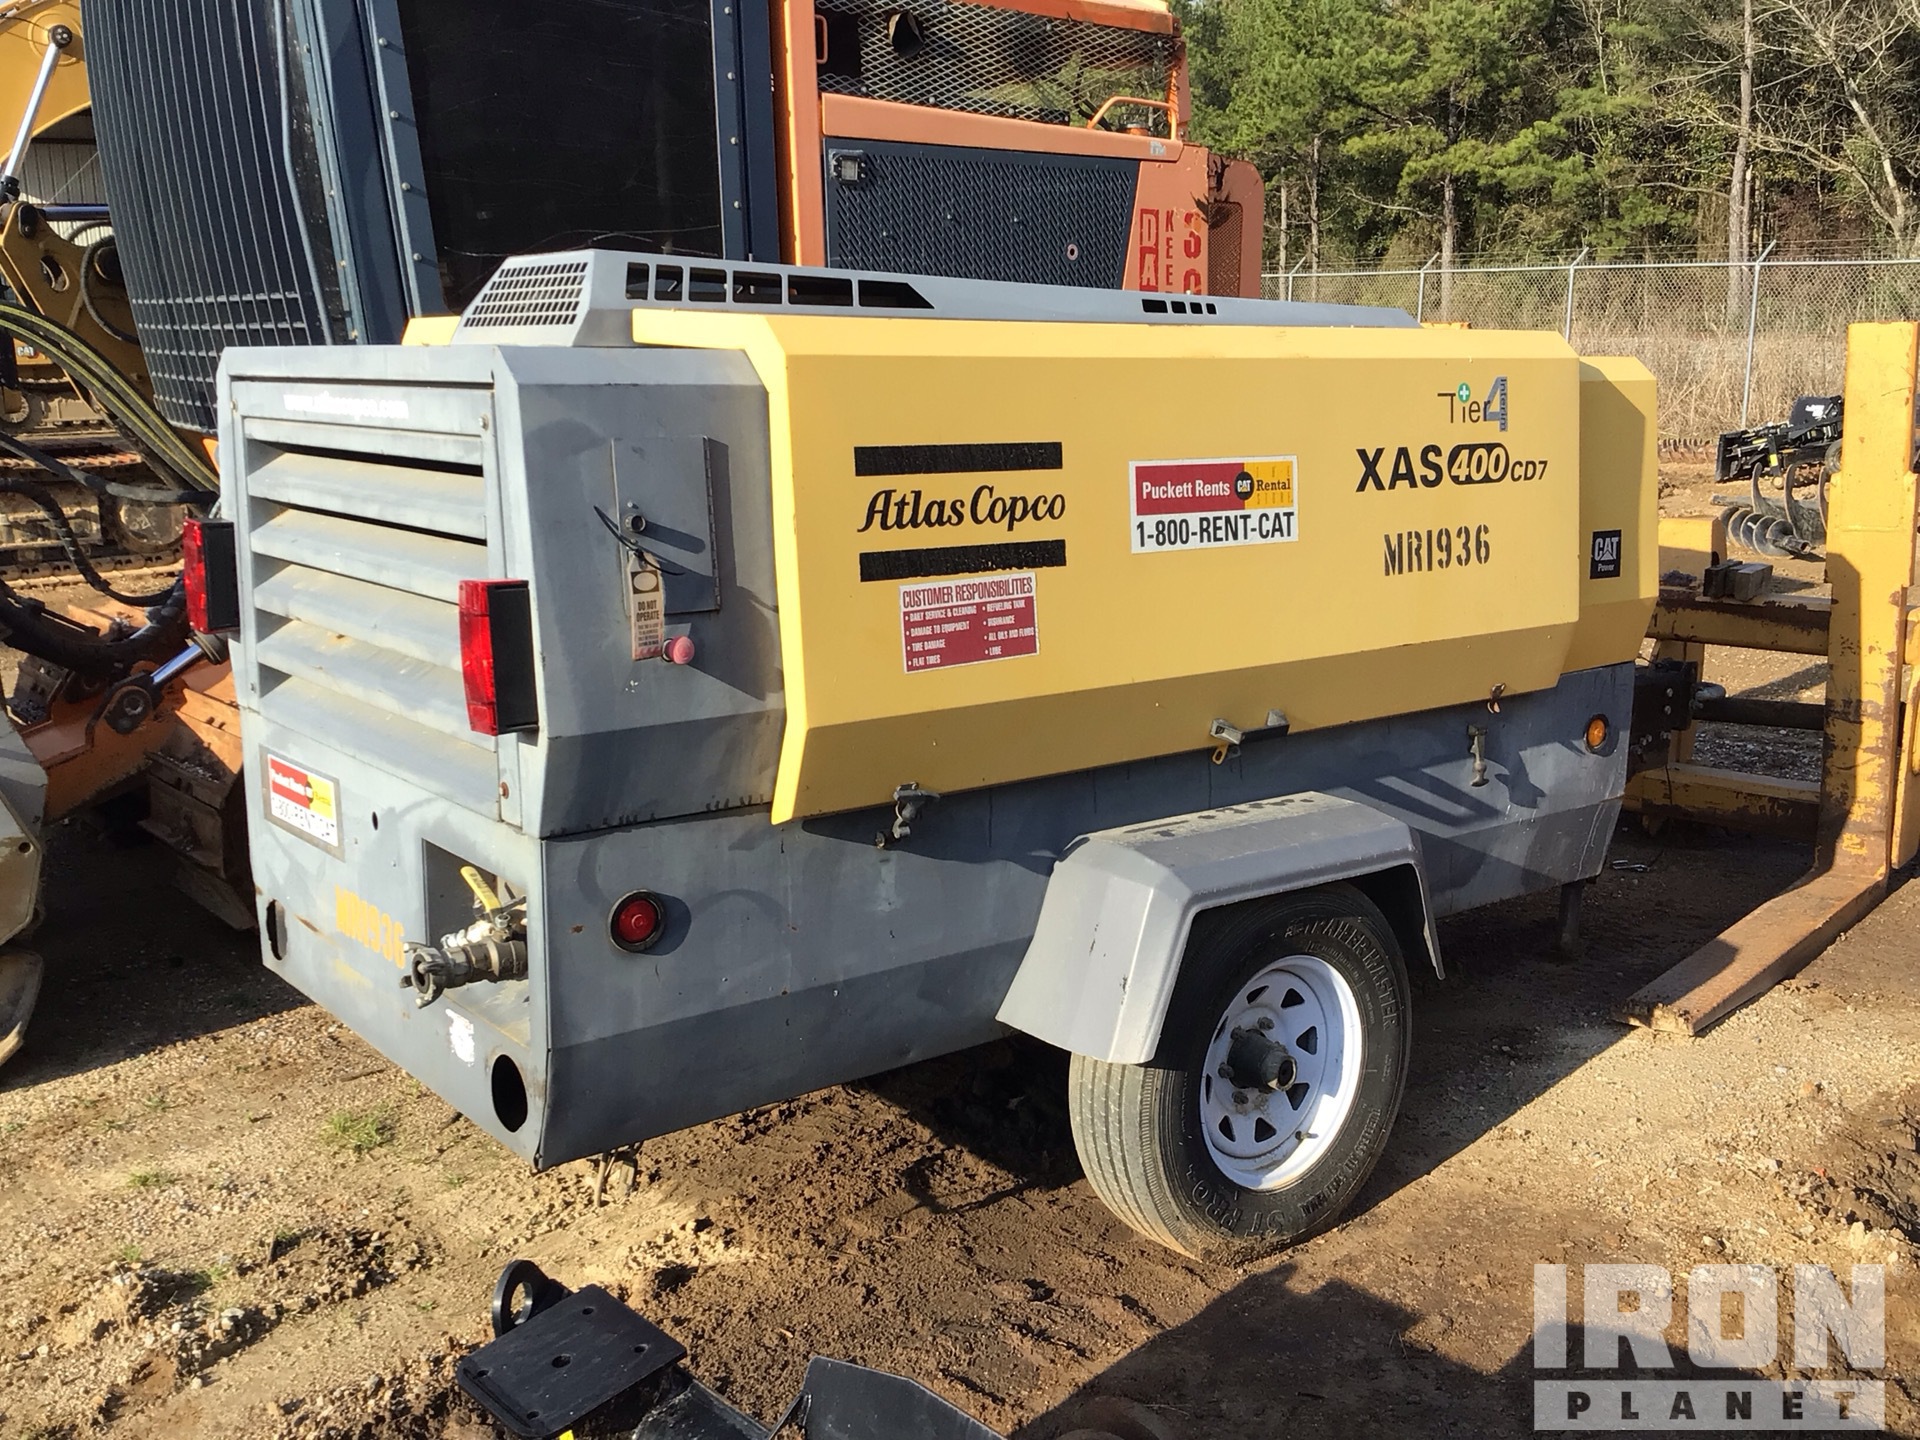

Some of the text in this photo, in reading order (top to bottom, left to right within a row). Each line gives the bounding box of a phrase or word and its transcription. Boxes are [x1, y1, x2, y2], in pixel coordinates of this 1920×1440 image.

[1437, 382, 1491, 423] Tier
[1142, 479, 1231, 499] Puckett Rents
[1236, 479, 1252, 493] CAT
[1256, 478, 1291, 492] Rental
[1136, 512, 1294, 547] 1-800-RENT-CAT
[1594, 537, 1619, 561] CAT
[1598, 563, 1615, 572] Power
[903, 577, 1033, 609] CUSTOMER RESPONSIBILITIES
[638, 600, 657, 611] DO NOT
[637, 610, 660, 622] OPERATE
[925, 609, 946, 620] SERVICE
[911, 621, 970, 637] DAMAGE TO EQUIPMENT
[988, 632, 997, 641] ALL
